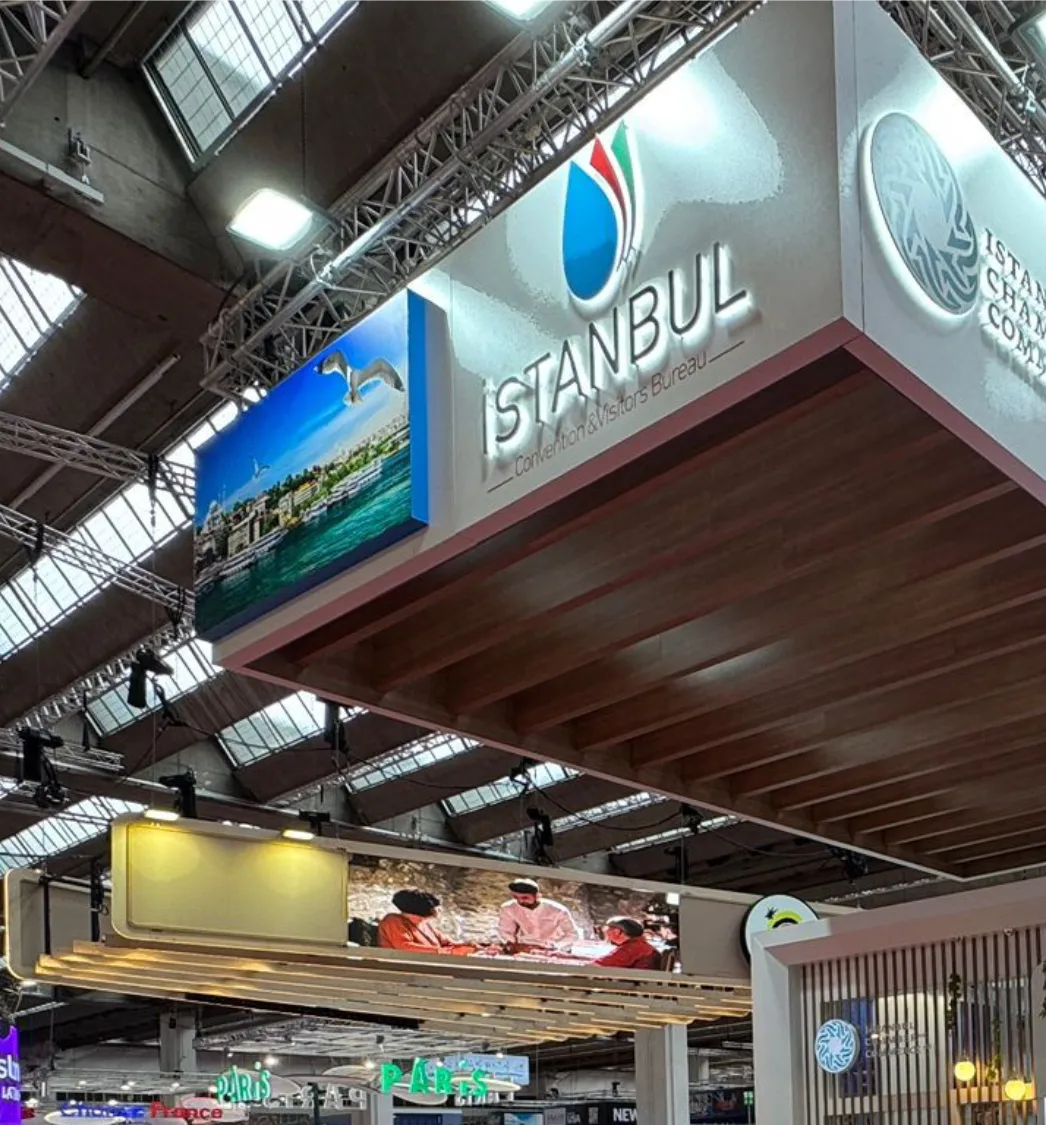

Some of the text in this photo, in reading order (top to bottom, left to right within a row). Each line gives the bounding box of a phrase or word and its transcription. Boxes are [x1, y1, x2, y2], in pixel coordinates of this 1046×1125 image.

[515, 422, 586, 477] Convention
[597, 385, 648, 427] Visitors
[650, 352, 707, 397] Bureau
[150, 1101, 223, 1119] France
